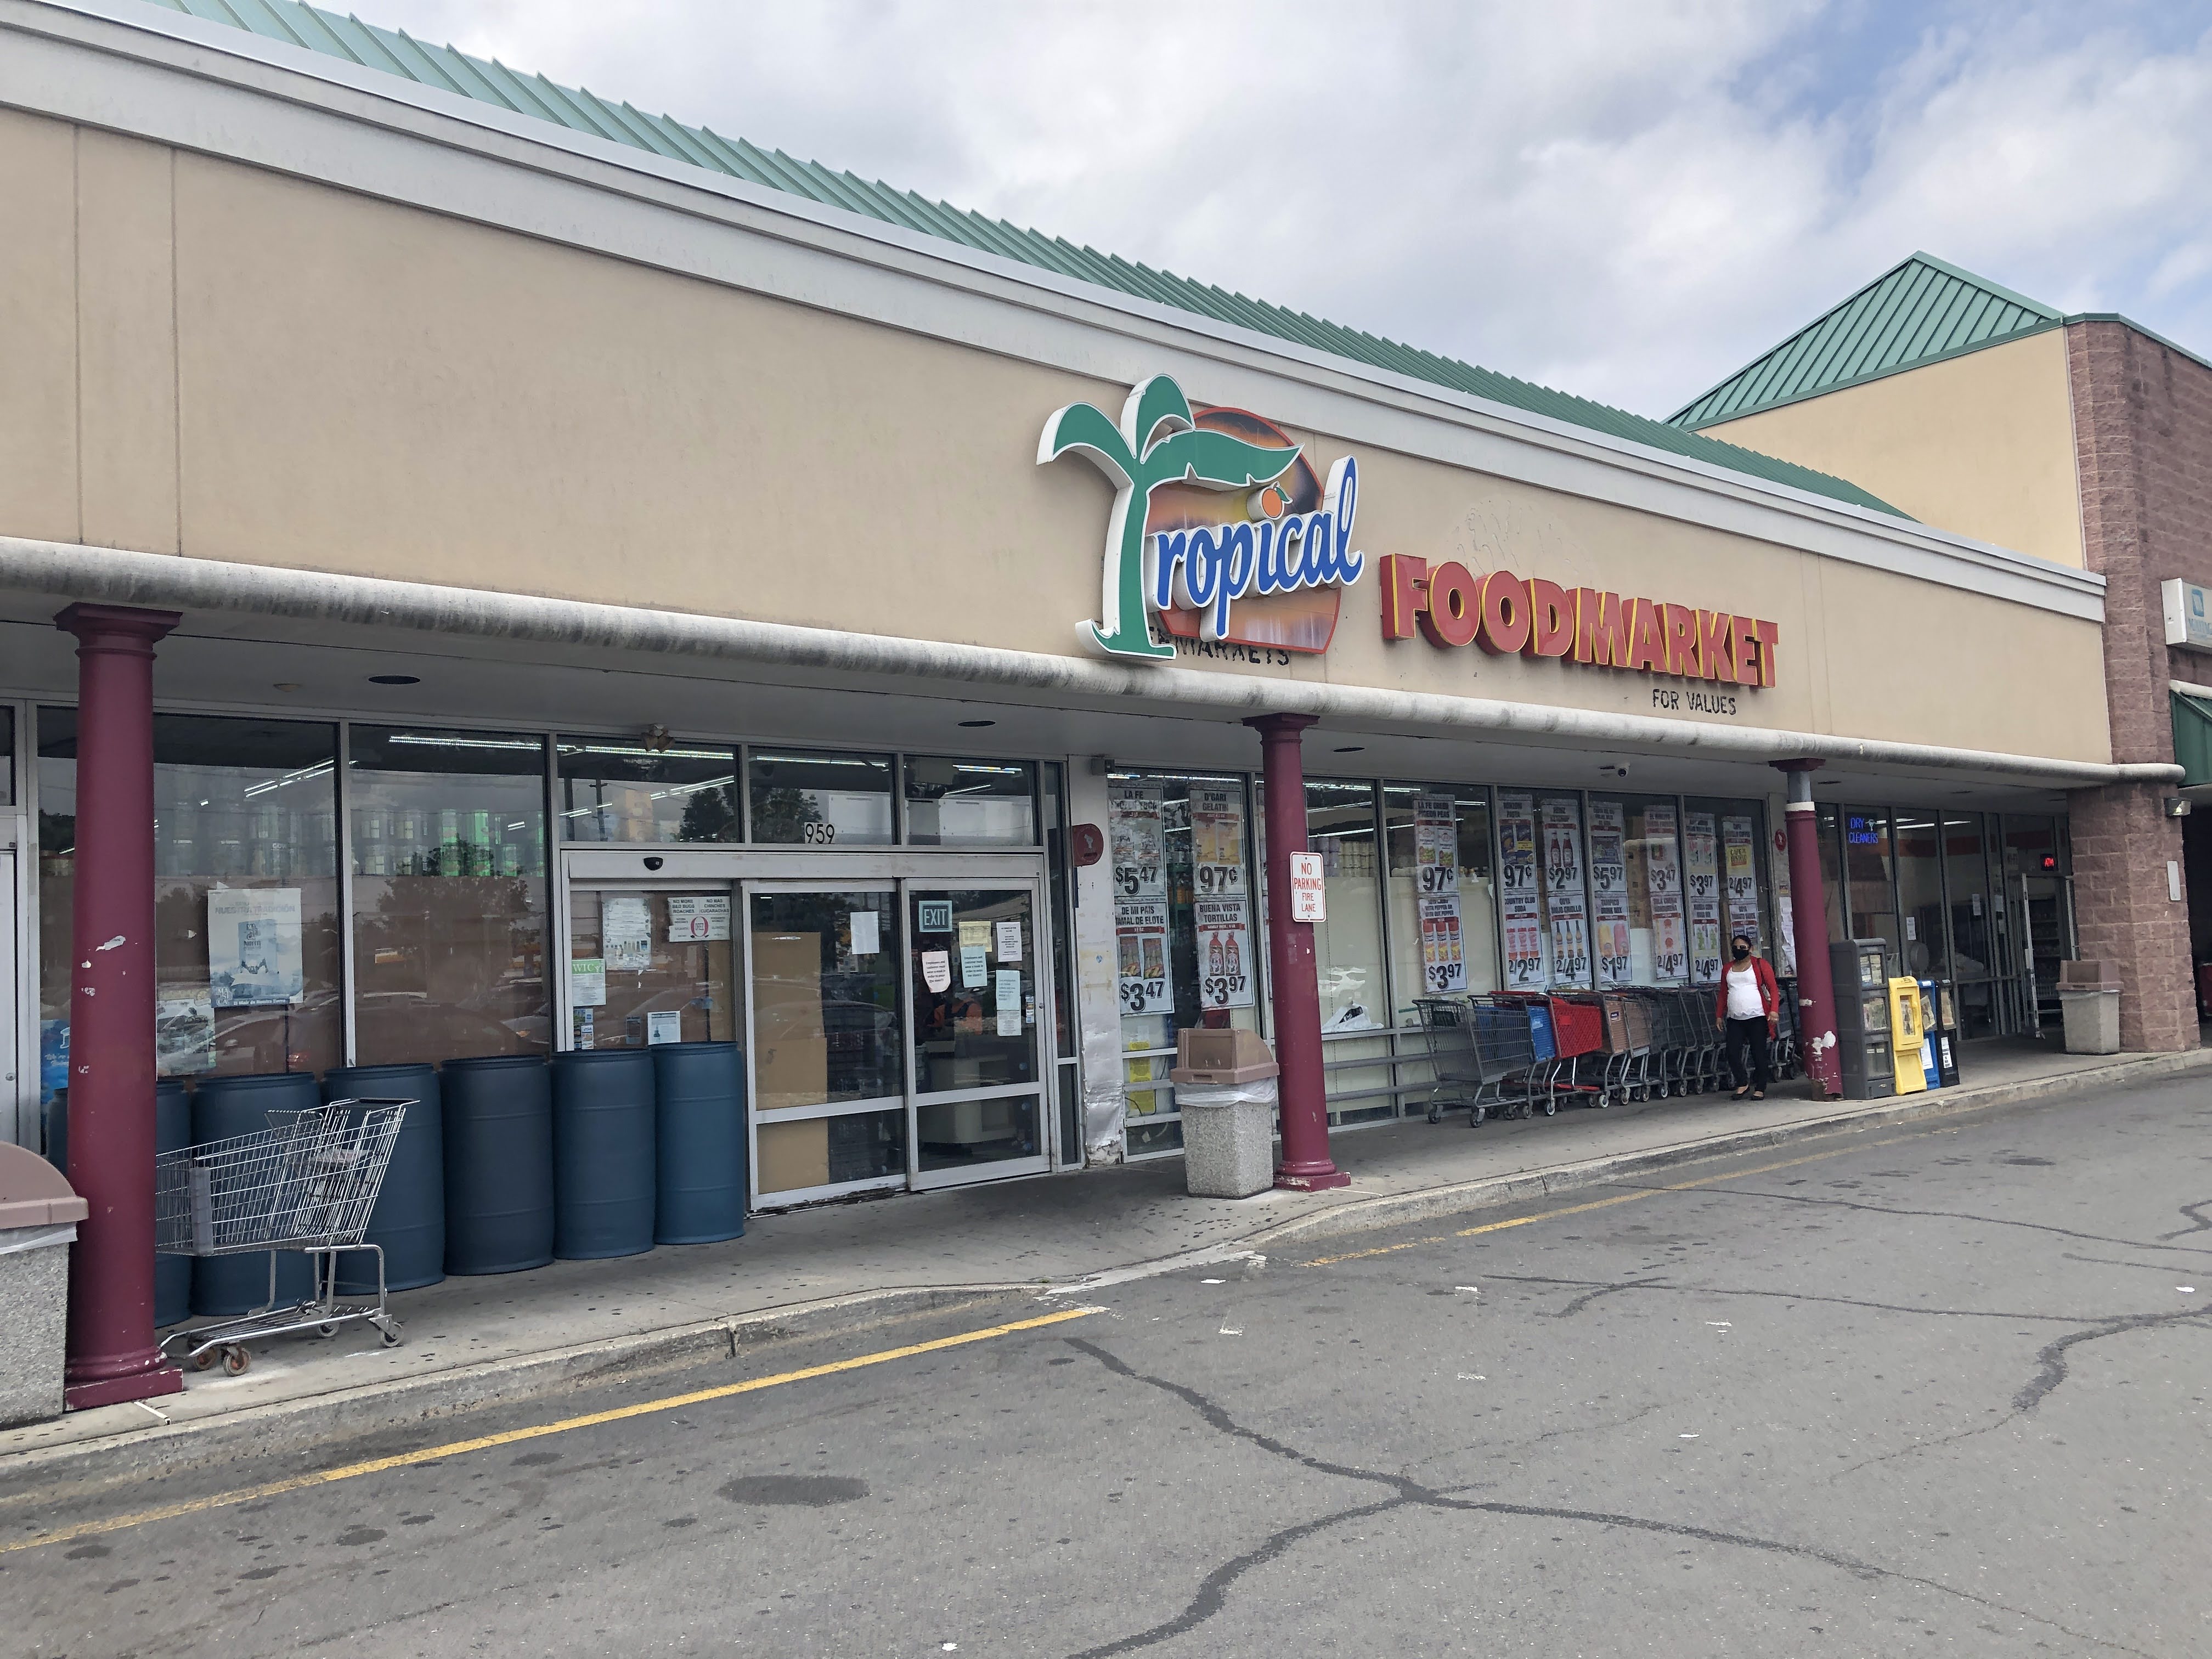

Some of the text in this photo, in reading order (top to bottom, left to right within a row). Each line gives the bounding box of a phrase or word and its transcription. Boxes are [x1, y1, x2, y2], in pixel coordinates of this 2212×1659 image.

[1652, 689, 1736, 715] FOR VALUES
[1124, 790, 1144, 799] LA FE
[1203, 803, 1229, 811] GELATIN
[1850, 817, 1864, 829] DRY
[805, 823, 834, 844] 959
[1849, 832, 1878, 844] CLEANERS
[1301, 862, 1312, 875] NO
[1294, 877, 1322, 890] PARKING
[1302, 892, 1314, 901] FIRE
[1122, 906, 1130, 915] DE
[1131, 906, 1139, 915] MI
[1199, 903, 1241, 913] BUENA VISTA
[1301, 903, 1316, 912] LANE
[924, 909, 947, 926] EXIT
[1115, 916, 1164, 926] TAMAL DE ELOTE
[1204, 913, 1238, 923] TORTILLAS
